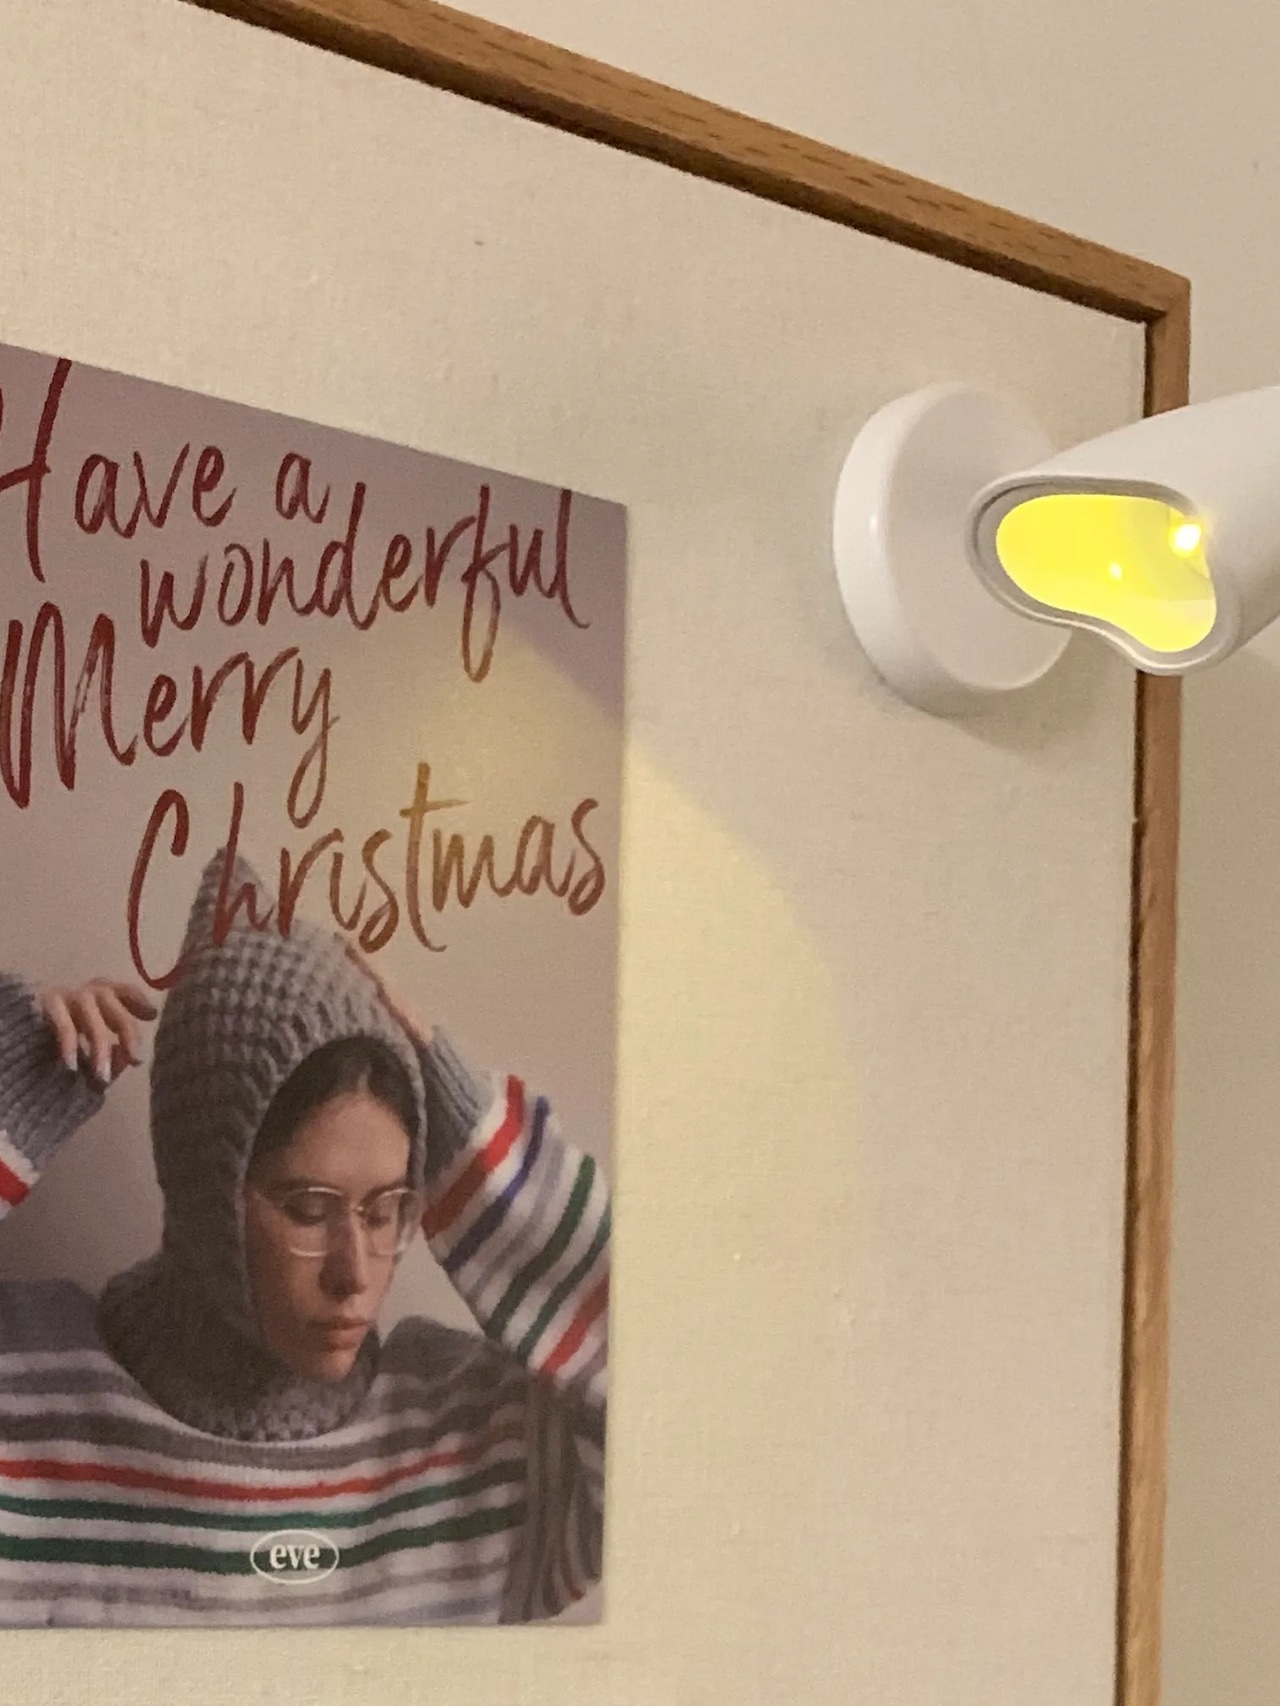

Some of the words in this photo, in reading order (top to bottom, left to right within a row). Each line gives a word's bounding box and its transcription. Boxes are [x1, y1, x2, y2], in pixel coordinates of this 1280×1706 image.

[274, 451, 330, 524] a
[141, 483, 591, 683] wonderful
[128, 762, 606, 991] Christmas
[269, 1543, 321, 1569] eve
